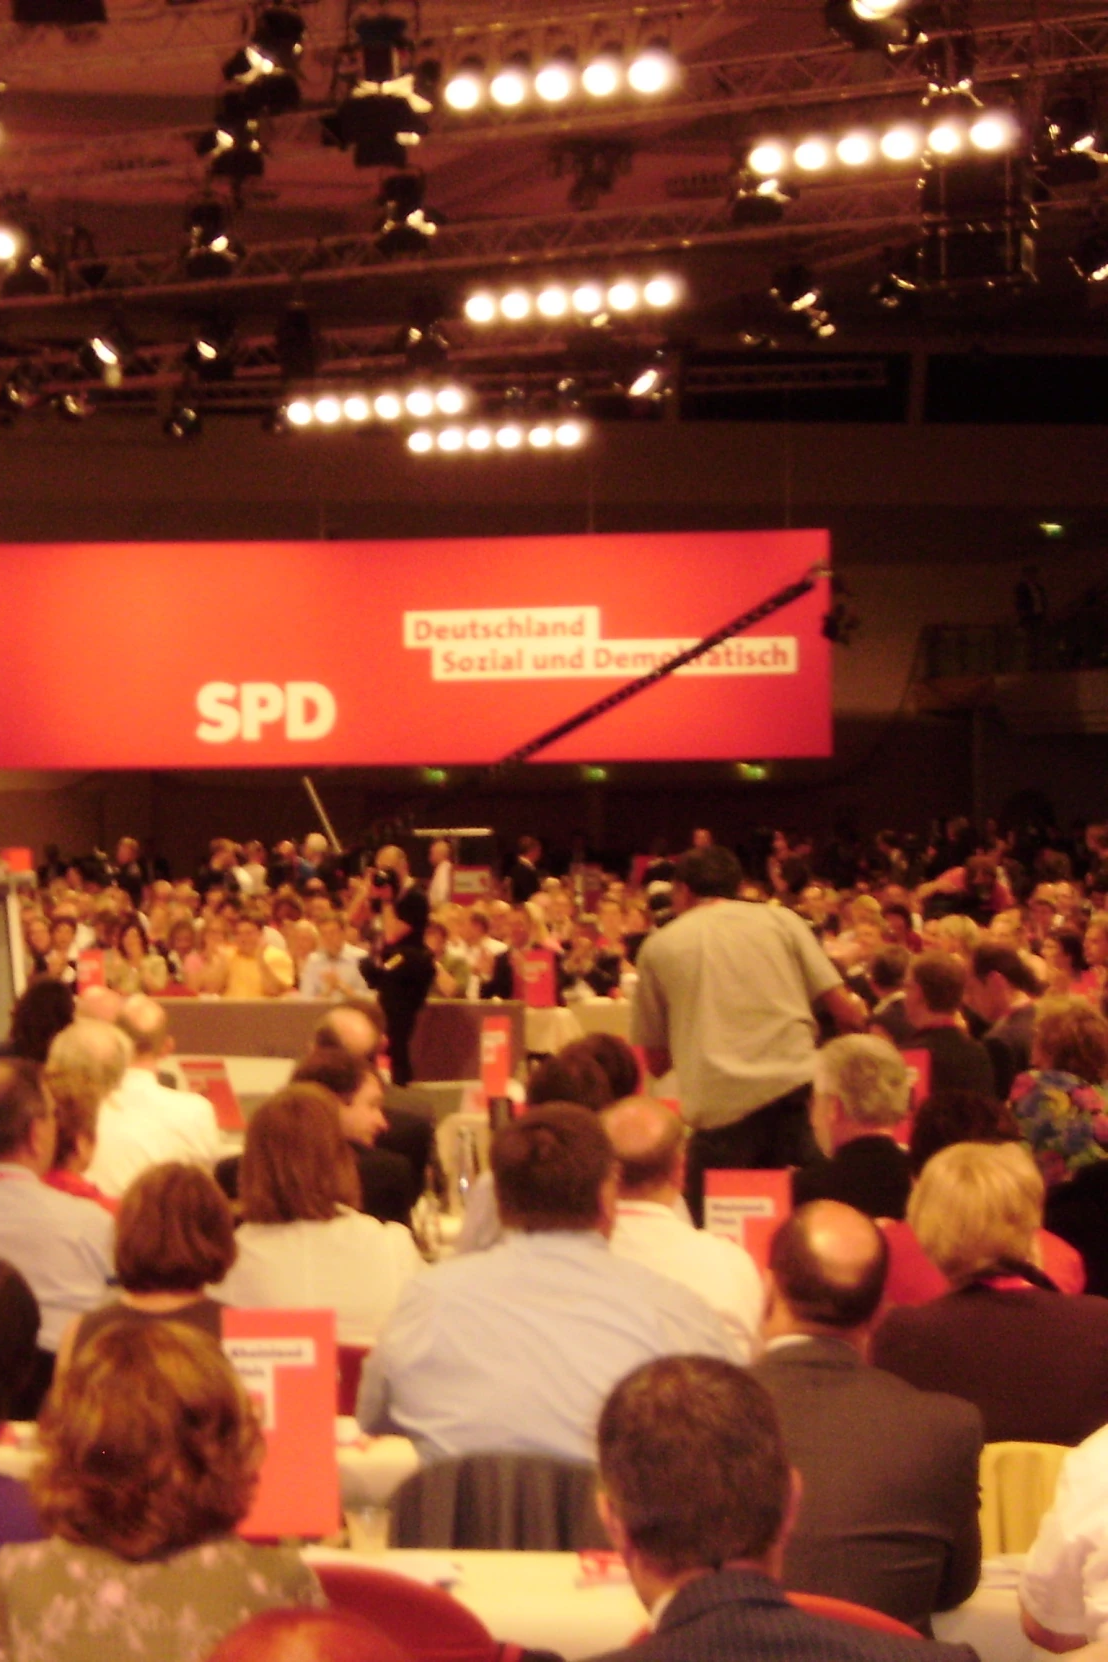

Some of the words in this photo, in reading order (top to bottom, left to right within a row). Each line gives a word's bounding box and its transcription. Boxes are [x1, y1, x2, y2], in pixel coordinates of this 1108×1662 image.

[413, 612, 585, 642] Deutschland
[442, 646, 524, 673] Sozial
[532, 645, 585, 671] und
[196, 681, 337, 743] SPD
